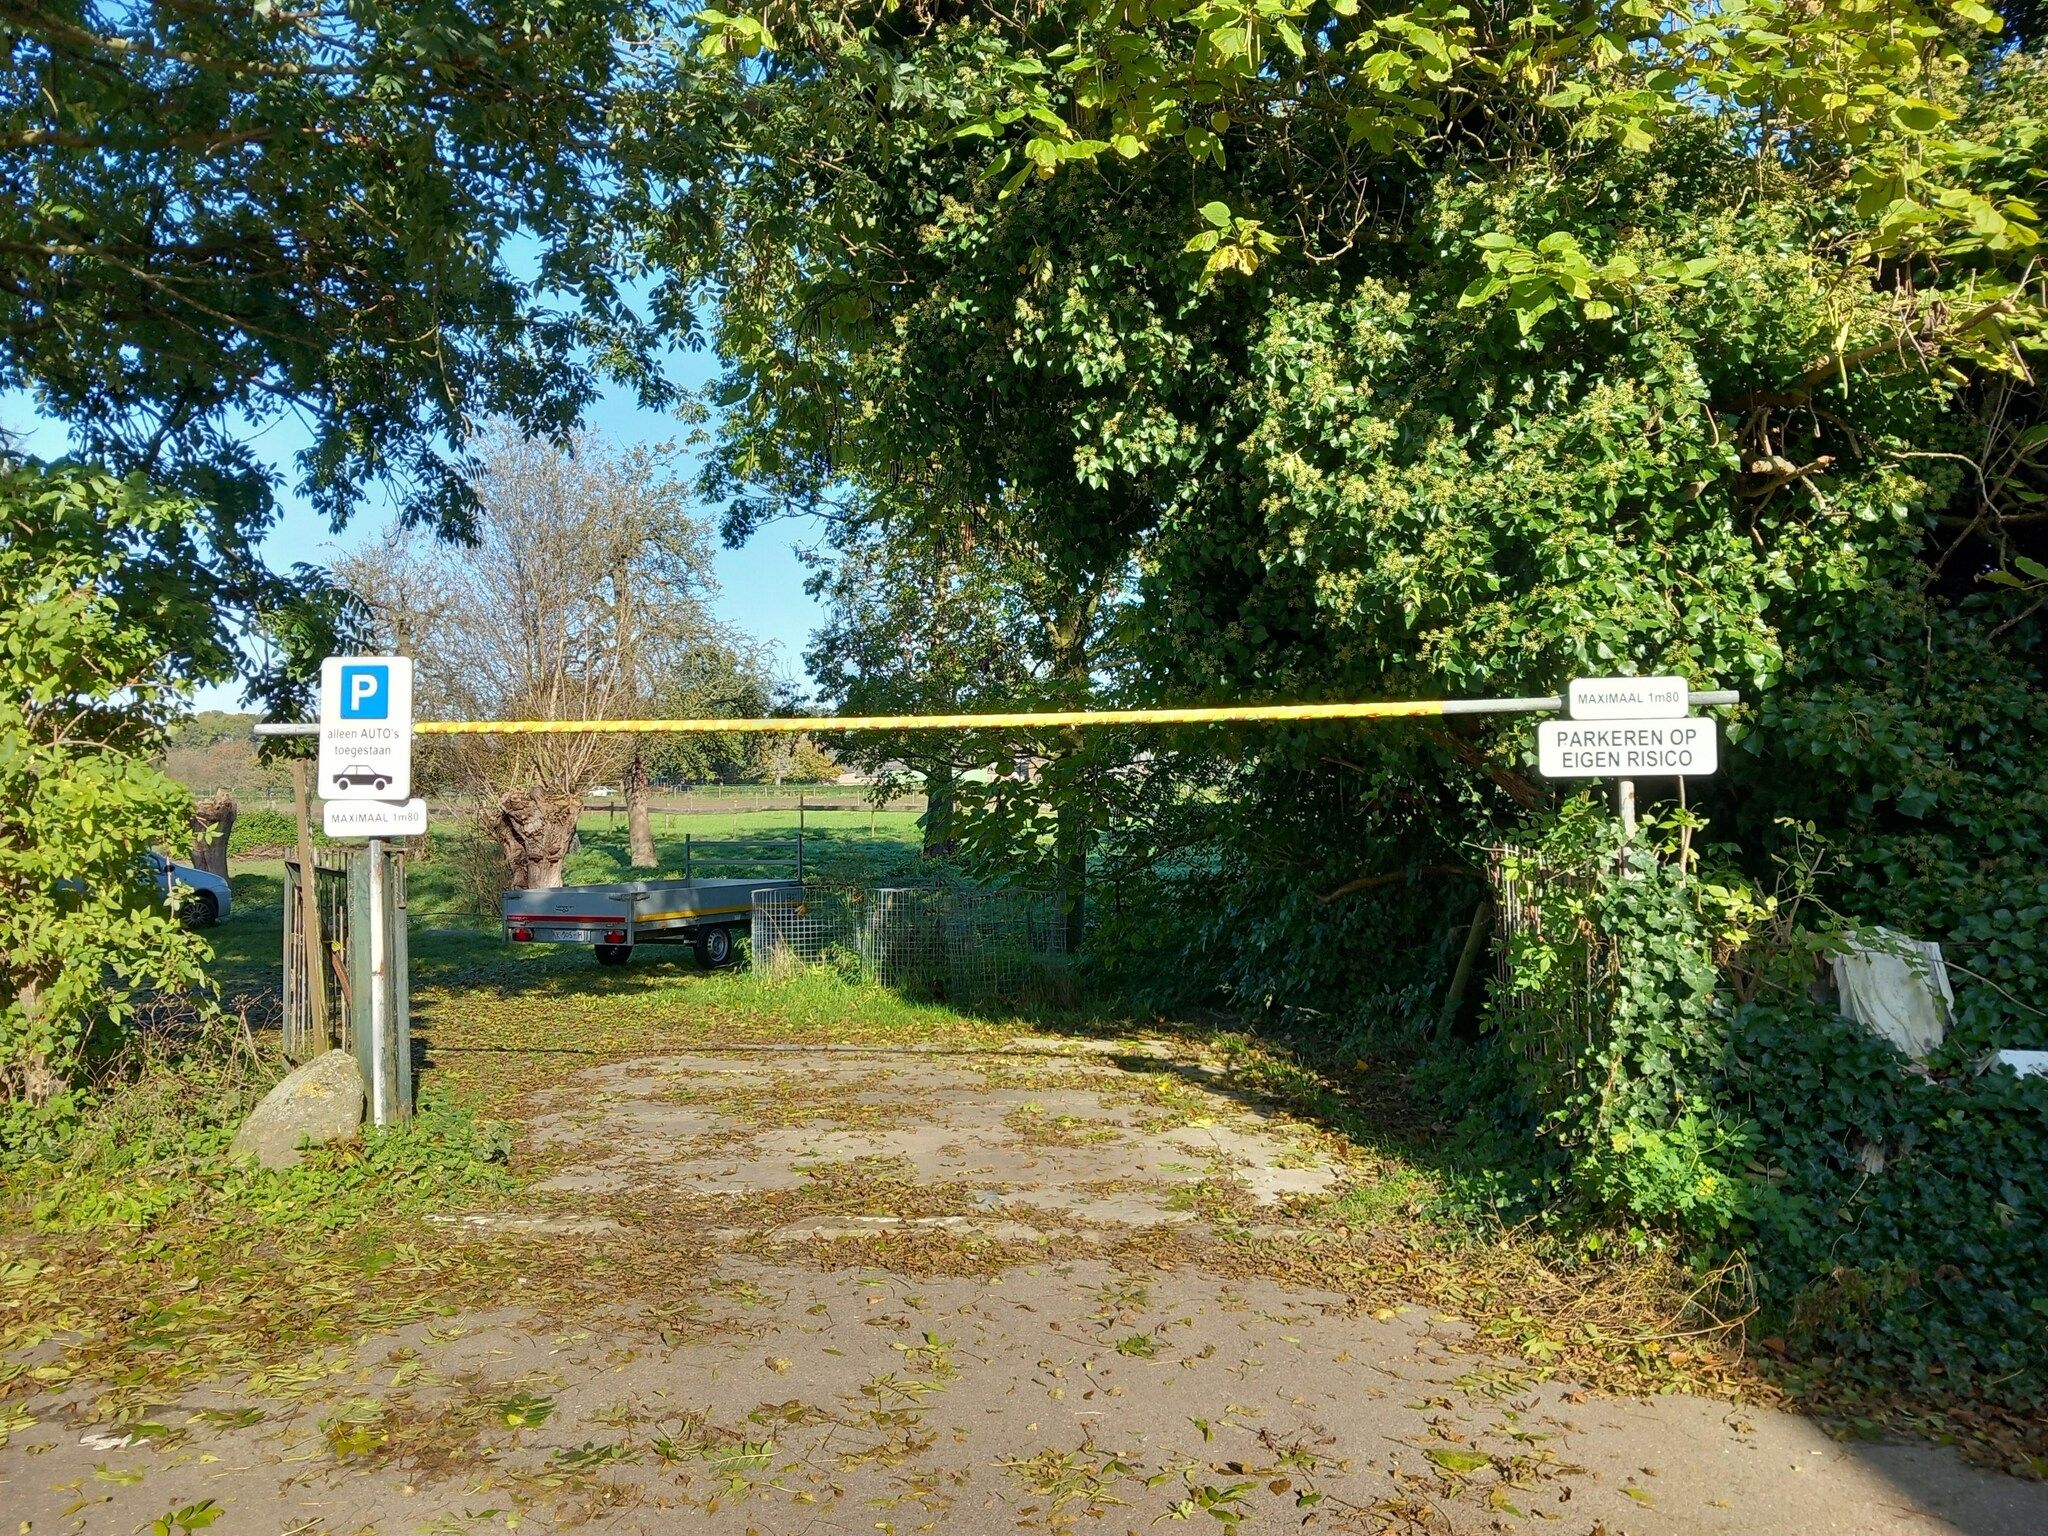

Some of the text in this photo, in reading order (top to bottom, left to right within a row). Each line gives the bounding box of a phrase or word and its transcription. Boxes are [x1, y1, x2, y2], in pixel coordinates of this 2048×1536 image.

[351, 674, 378, 711] P
[1578, 692, 1679, 704] MAXIMAAL 1m80
[327, 728, 400, 739] alleen AUTO's
[1557, 729, 1696, 747] PARKEREN OP
[334, 745, 391, 758] toegestaan
[1562, 750, 1692, 768] EIGEN RISICO
[331, 813, 419, 823] MAXIMAAL 1m80
